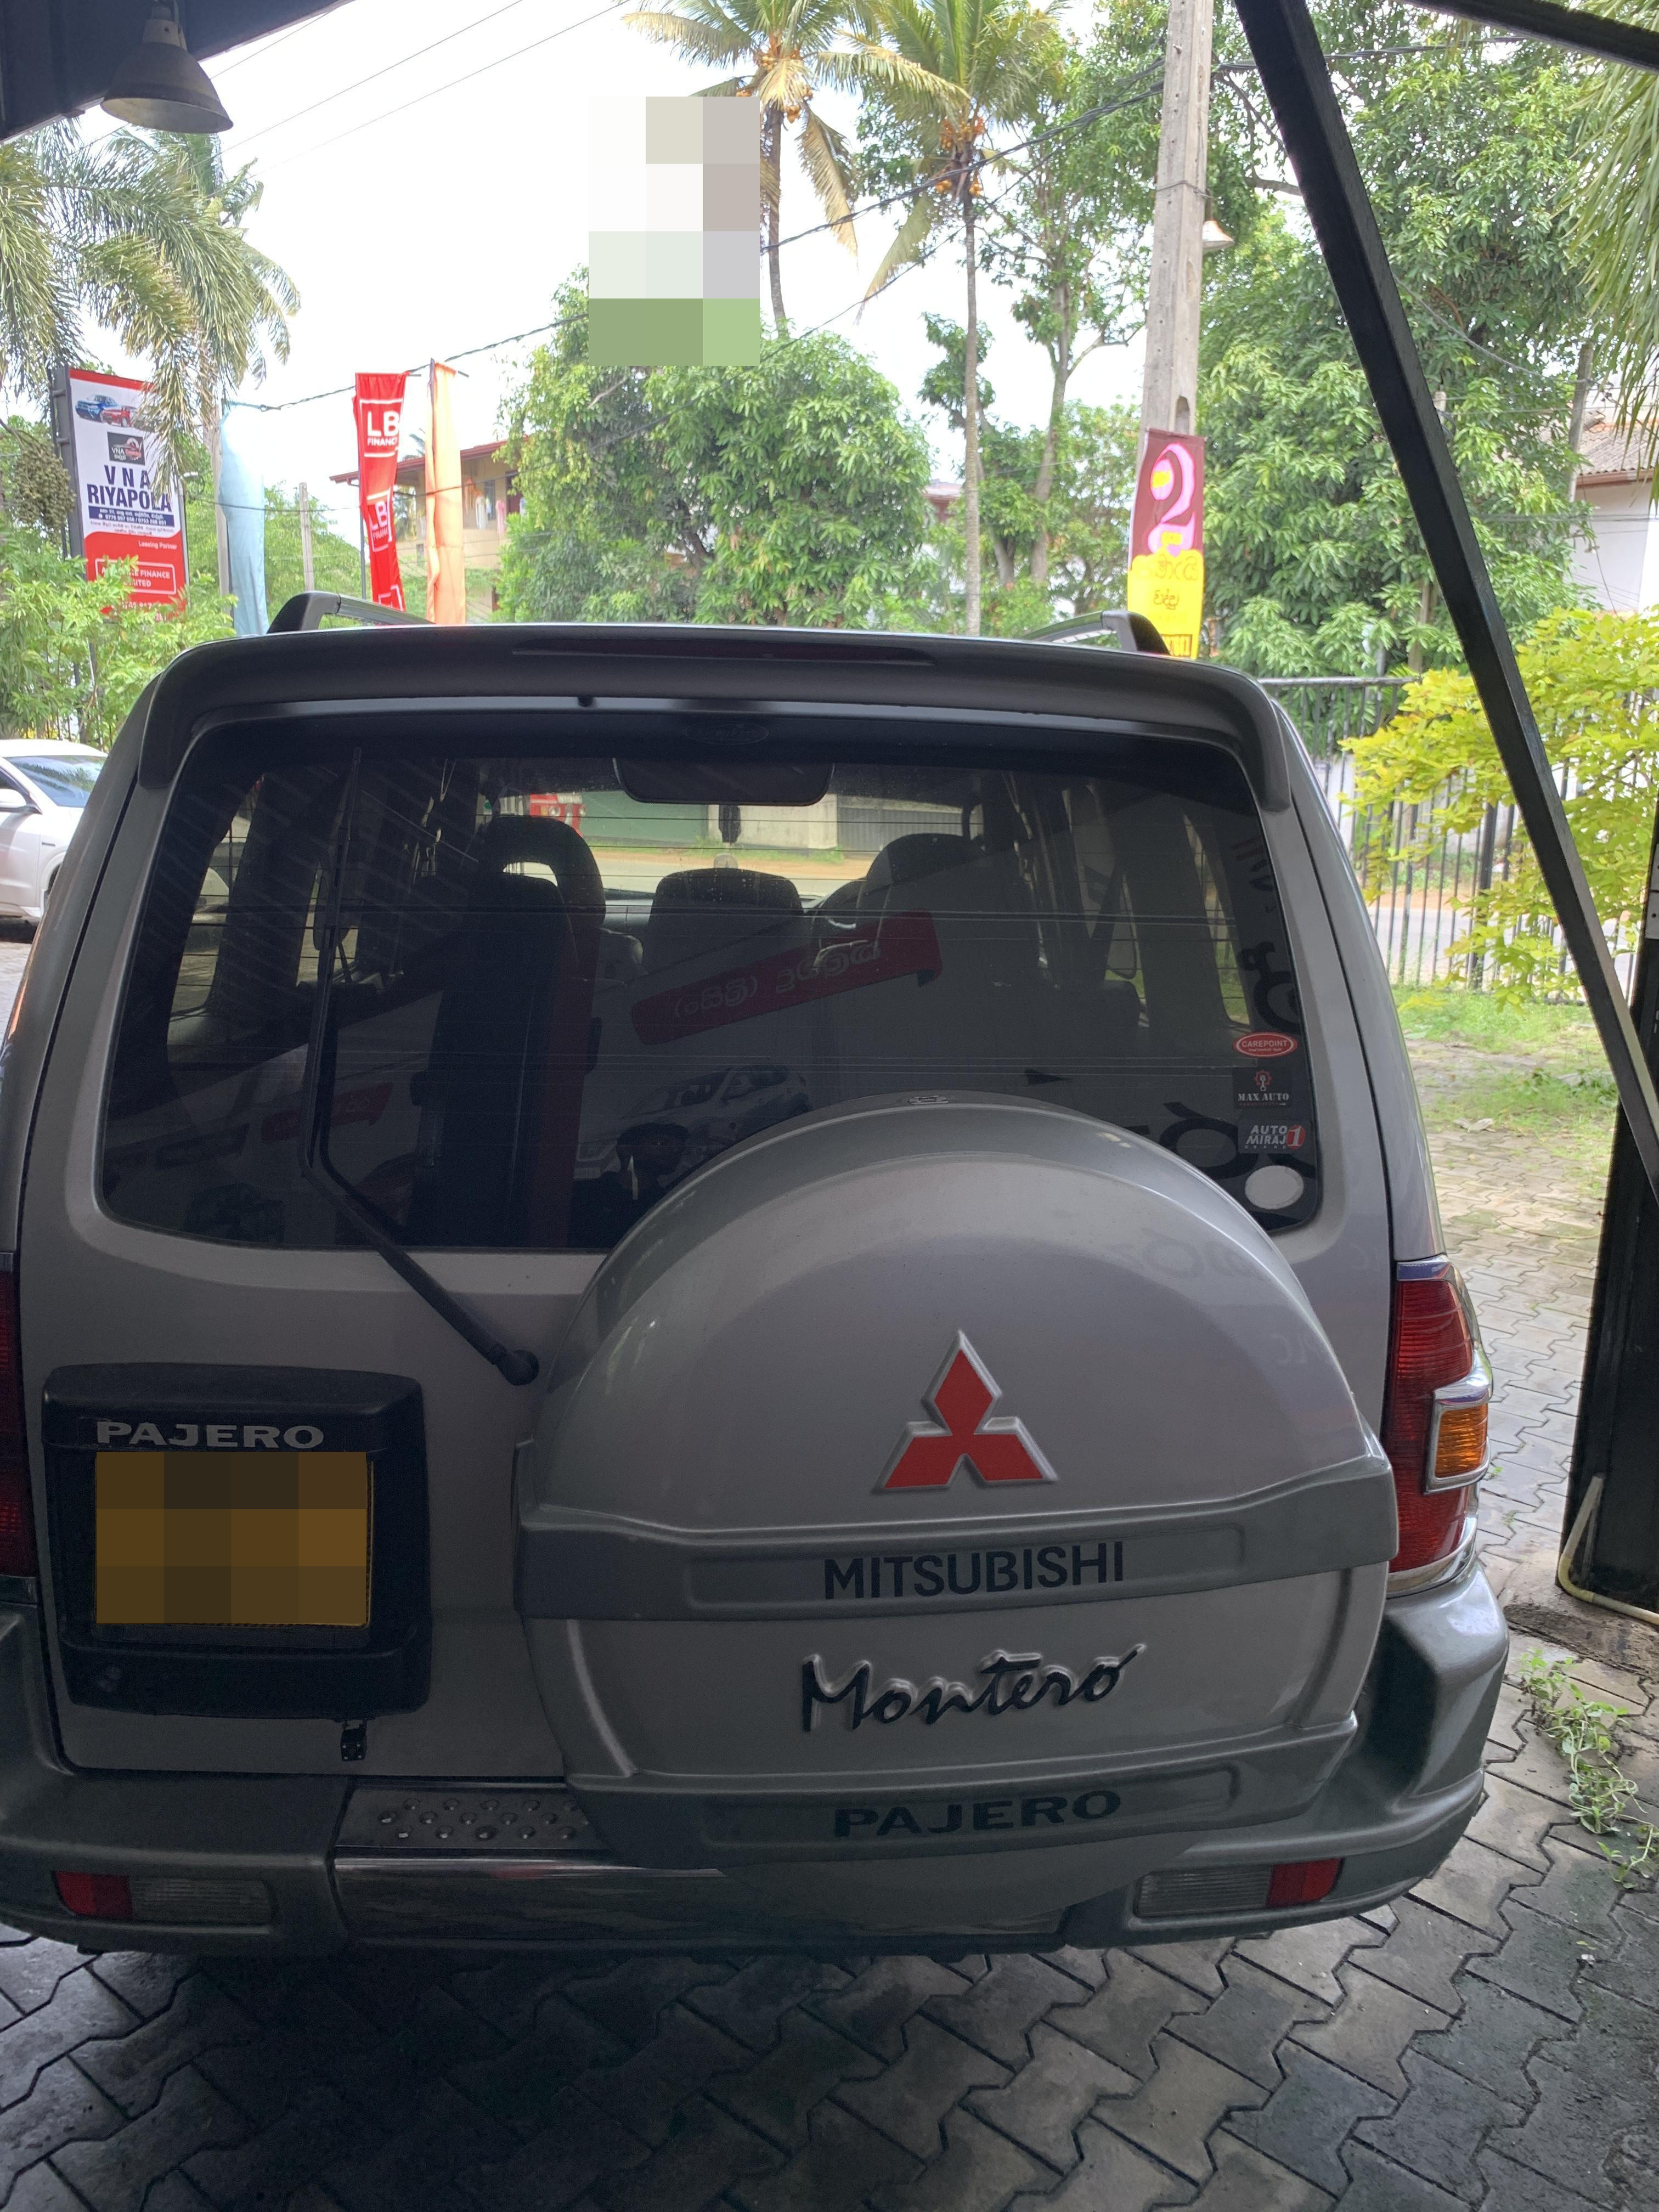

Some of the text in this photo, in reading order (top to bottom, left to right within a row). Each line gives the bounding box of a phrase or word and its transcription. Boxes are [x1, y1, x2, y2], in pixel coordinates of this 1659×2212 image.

[367, 411, 399, 437] LB
[367, 437, 398, 446] FINANC
[138, 540, 159, 549] Leasing
[140, 569, 171, 579] FINANCE
[1238, 1093, 1290, 1102] MAX AUTO
[1246, 1135, 1287, 1145] MIRAJ
[1250, 1125, 1302, 1146] AUTO 1
[96, 1420, 325, 1449] PAJERO
[824, 1540, 1124, 1600] MITSUBISHI
[801, 1645, 1147, 1732] Montero
[834, 1790, 1121, 1838] PAJERO
